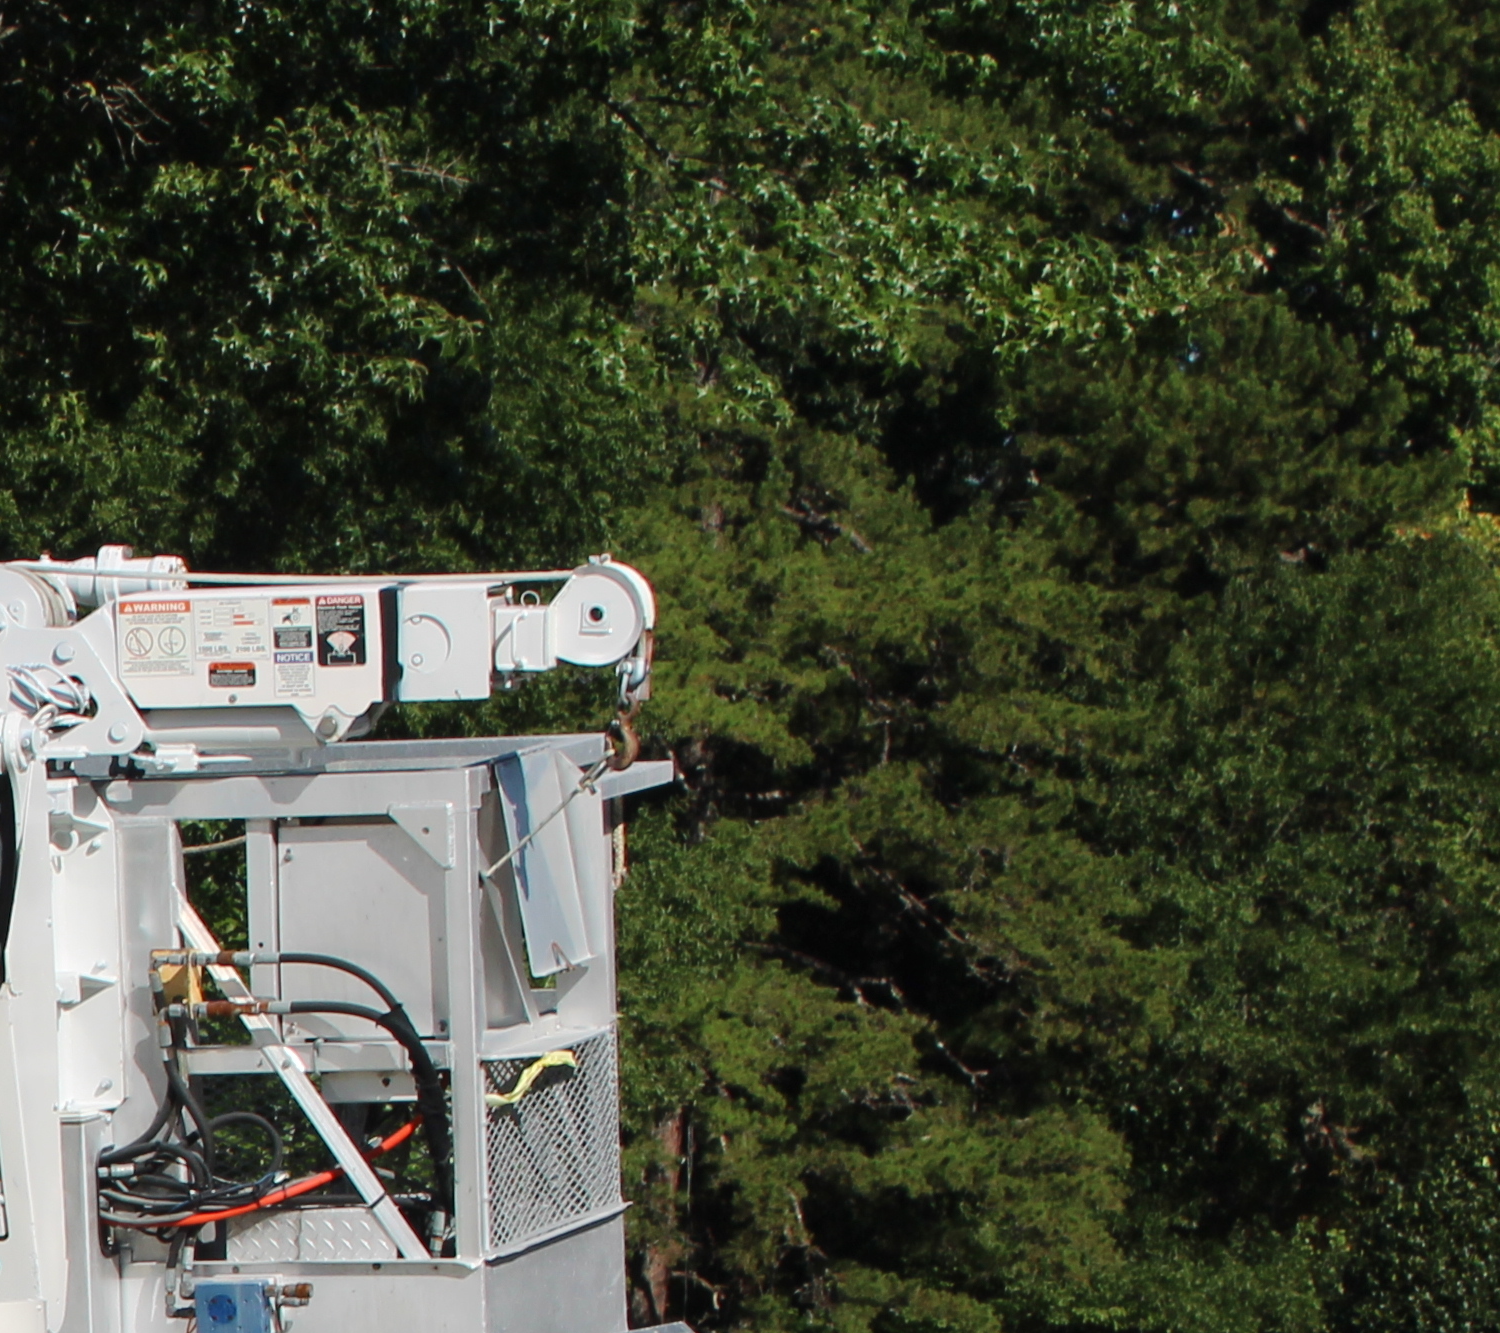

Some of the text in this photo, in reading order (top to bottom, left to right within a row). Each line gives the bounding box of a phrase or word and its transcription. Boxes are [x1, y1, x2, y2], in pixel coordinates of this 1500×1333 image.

[327, 596, 361, 605] DANGER
[133, 602, 186, 612] WARNING
[276, 653, 311, 662] NOTICE
